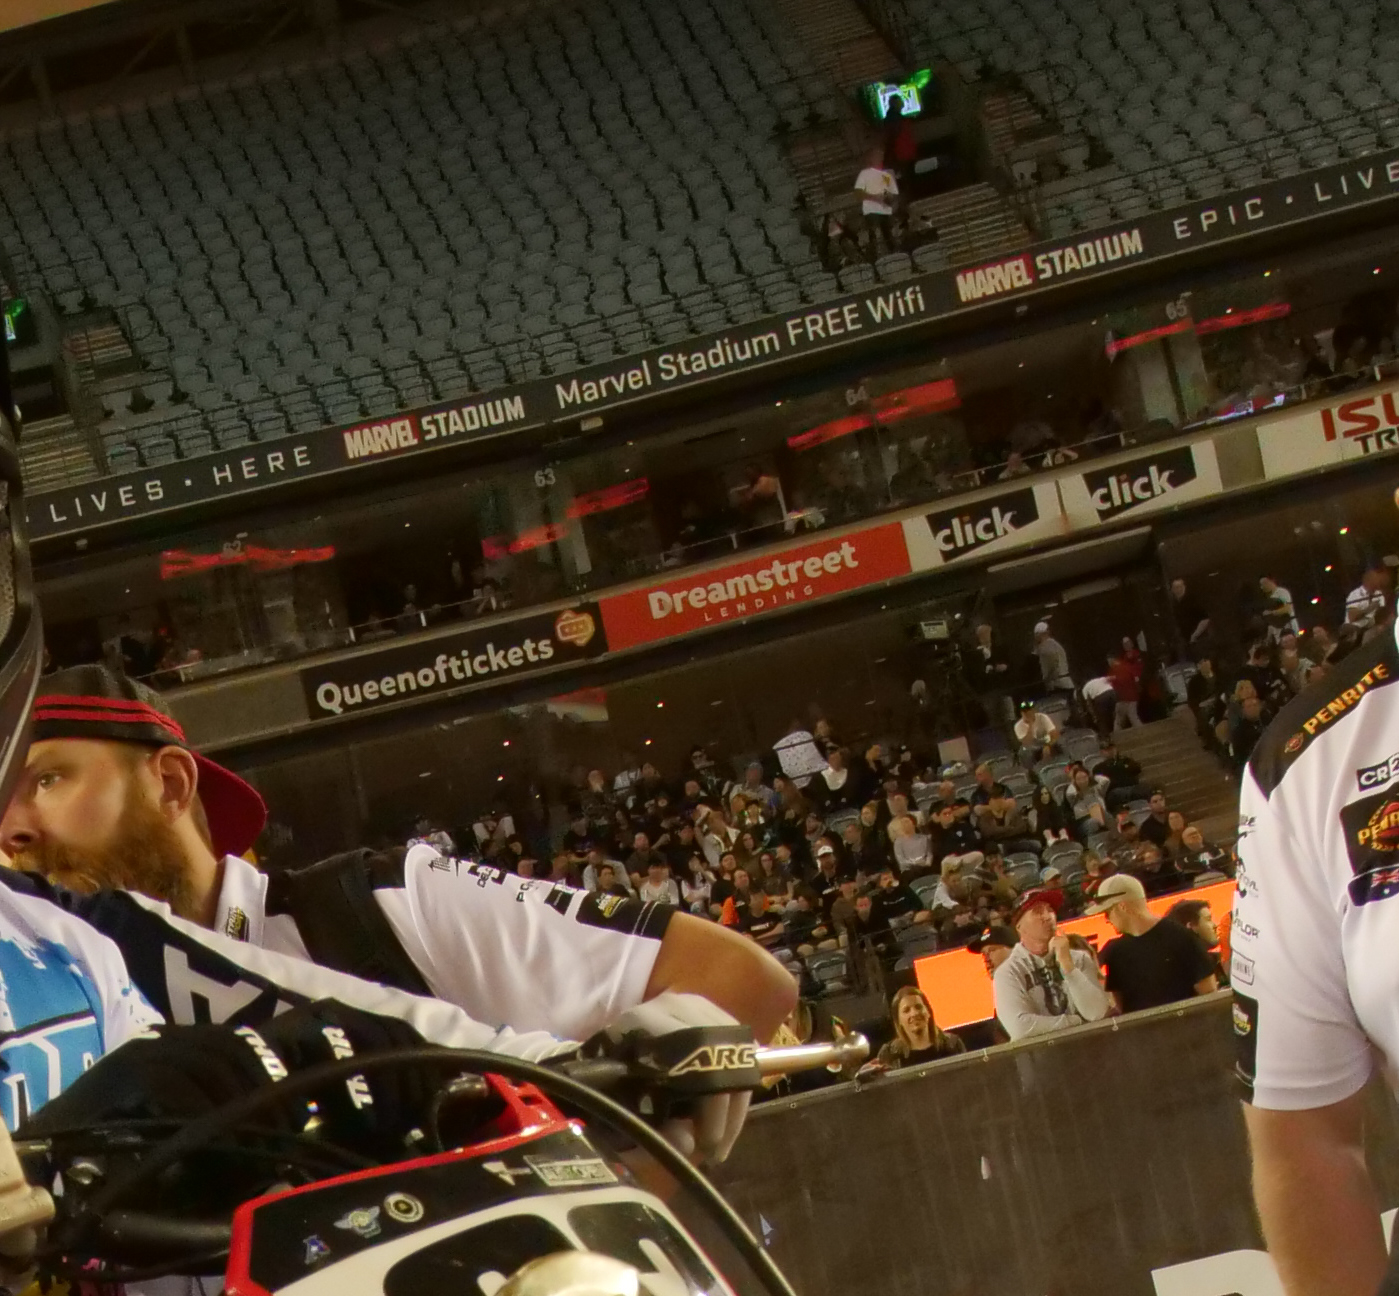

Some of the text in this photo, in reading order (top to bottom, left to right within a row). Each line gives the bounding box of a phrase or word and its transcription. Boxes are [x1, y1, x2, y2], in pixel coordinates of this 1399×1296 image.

[1173, 198, 1264, 239] EPIC
[956, 229, 1144, 302] MARVEL STADIUM
[555, 285, 926, 410] Marvel Stadium FREE Wifi
[343, 395, 525, 459] MARVEL STADIUM
[49, 446, 311, 523] LIVES HERE
[1094, 465, 1175, 511] click
[936, 506, 1016, 552] click
[648, 541, 859, 620] Dreamstreet
[704, 585, 816, 622] LENDING
[316, 633, 555, 715] Queenoftickets
[1303, 663, 1390, 736] PENRITE
[668, 1044, 757, 1078] ARC
